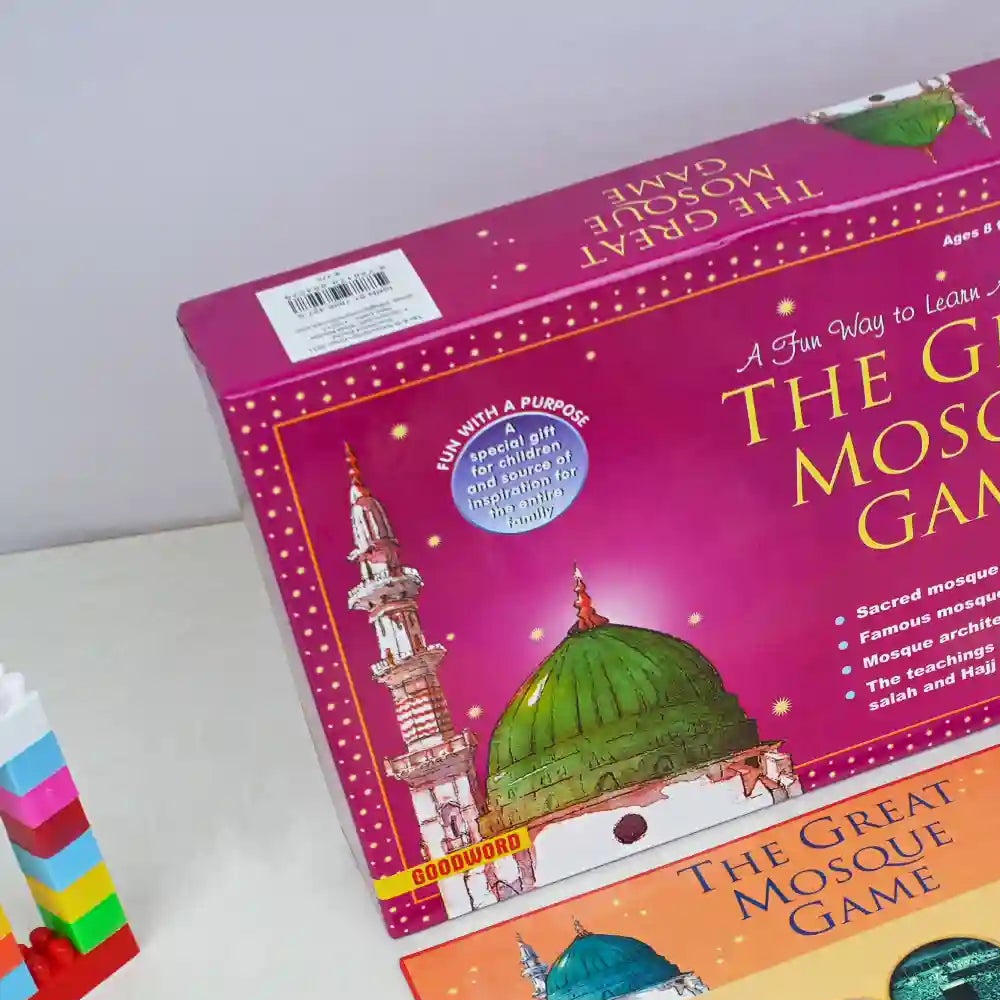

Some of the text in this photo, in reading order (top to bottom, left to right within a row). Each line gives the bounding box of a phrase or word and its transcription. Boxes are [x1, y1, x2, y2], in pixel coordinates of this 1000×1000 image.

[584, 163, 775, 236] MOSQUE
[602, 158, 727, 205] GAME
[580, 179, 823, 269] THE GREAT
[942, 228, 980, 247] Ages
[983, 222, 993, 235] 8
[737, 343, 764, 373] A
[771, 329, 823, 366] Fun
[827, 311, 885, 342] Way
[893, 305, 915, 325] to
[925, 284, 981, 315] Learn
[721, 349, 893, 447] THE
[436, 395, 590, 471] FUN WITH A PURPOSE
[469, 424, 557, 463] special gift
[505, 422, 516, 435] A
[467, 450, 573, 496] and source of
[471, 440, 562, 478] for children
[554, 466, 578, 481] for
[490, 487, 565, 519] the entire
[856, 588, 922, 619] Sacred
[927, 564, 999, 597] mosque
[859, 612, 932, 644] Famous
[862, 638, 934, 669] Mosque
[865, 675, 901, 693] The
[906, 642, 995, 680] teachings
[868, 658, 997, 711] salah and Hajj
[411, 833, 521, 885] GOODWORD
[677, 779, 957, 894] THE GREAT
[733, 821, 953, 920] MOSQUE
[789, 865, 941, 936] GAME
